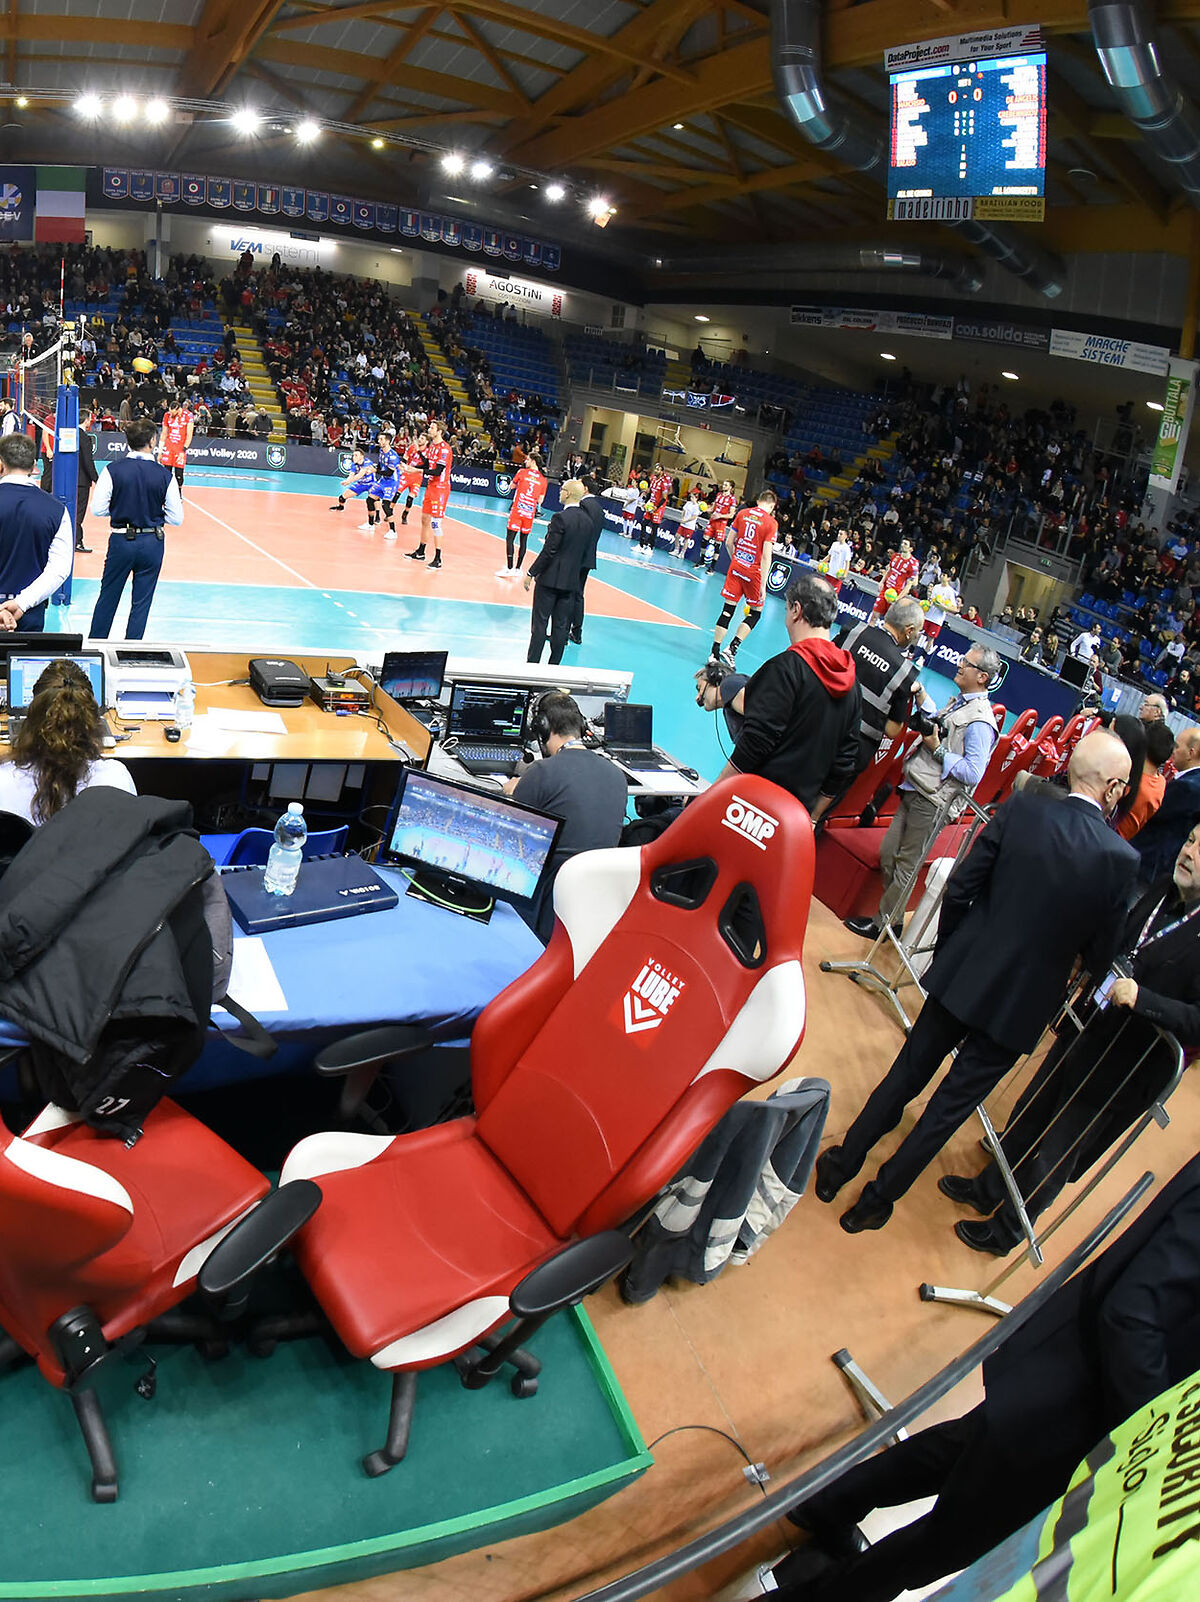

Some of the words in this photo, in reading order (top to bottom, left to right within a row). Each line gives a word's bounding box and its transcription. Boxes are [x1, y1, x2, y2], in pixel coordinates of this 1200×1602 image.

[960, 34, 993, 45] Multimedia
[994, 30, 1022, 41] Solutions
[970, 45, 979, 53] for
[981, 43, 996, 52] Your
[997, 42, 1012, 52] Sport
[887, 44, 950, 64] DataProject.com
[948, 90, 958, 104] 0
[973, 88, 983, 102] 0
[898, 196, 969, 220] madeirinho
[230, 238, 262, 253] VEM
[264, 244, 320, 262] sistemi
[955, 323, 1023, 342] con.solida
[1084, 336, 1131, 353] MARCHE
[1080, 348, 1125, 366] SISTEMI
[1163, 379, 1182, 423] BUTTALA
[108, 442, 127, 452] CEV
[210, 448, 236, 460] Volley
[237, 450, 257, 460] 2020
[451, 473, 471, 487] Volley
[472, 477, 490, 488] 2020
[743, 521, 756, 541] 16
[857, 645, 890, 673] PHOTO
[725, 802, 775, 842] OMP
[648, 957, 687, 990] VOLLEY
[631, 964, 682, 1017] LUBE
[95, 1095, 131, 1117] 27
